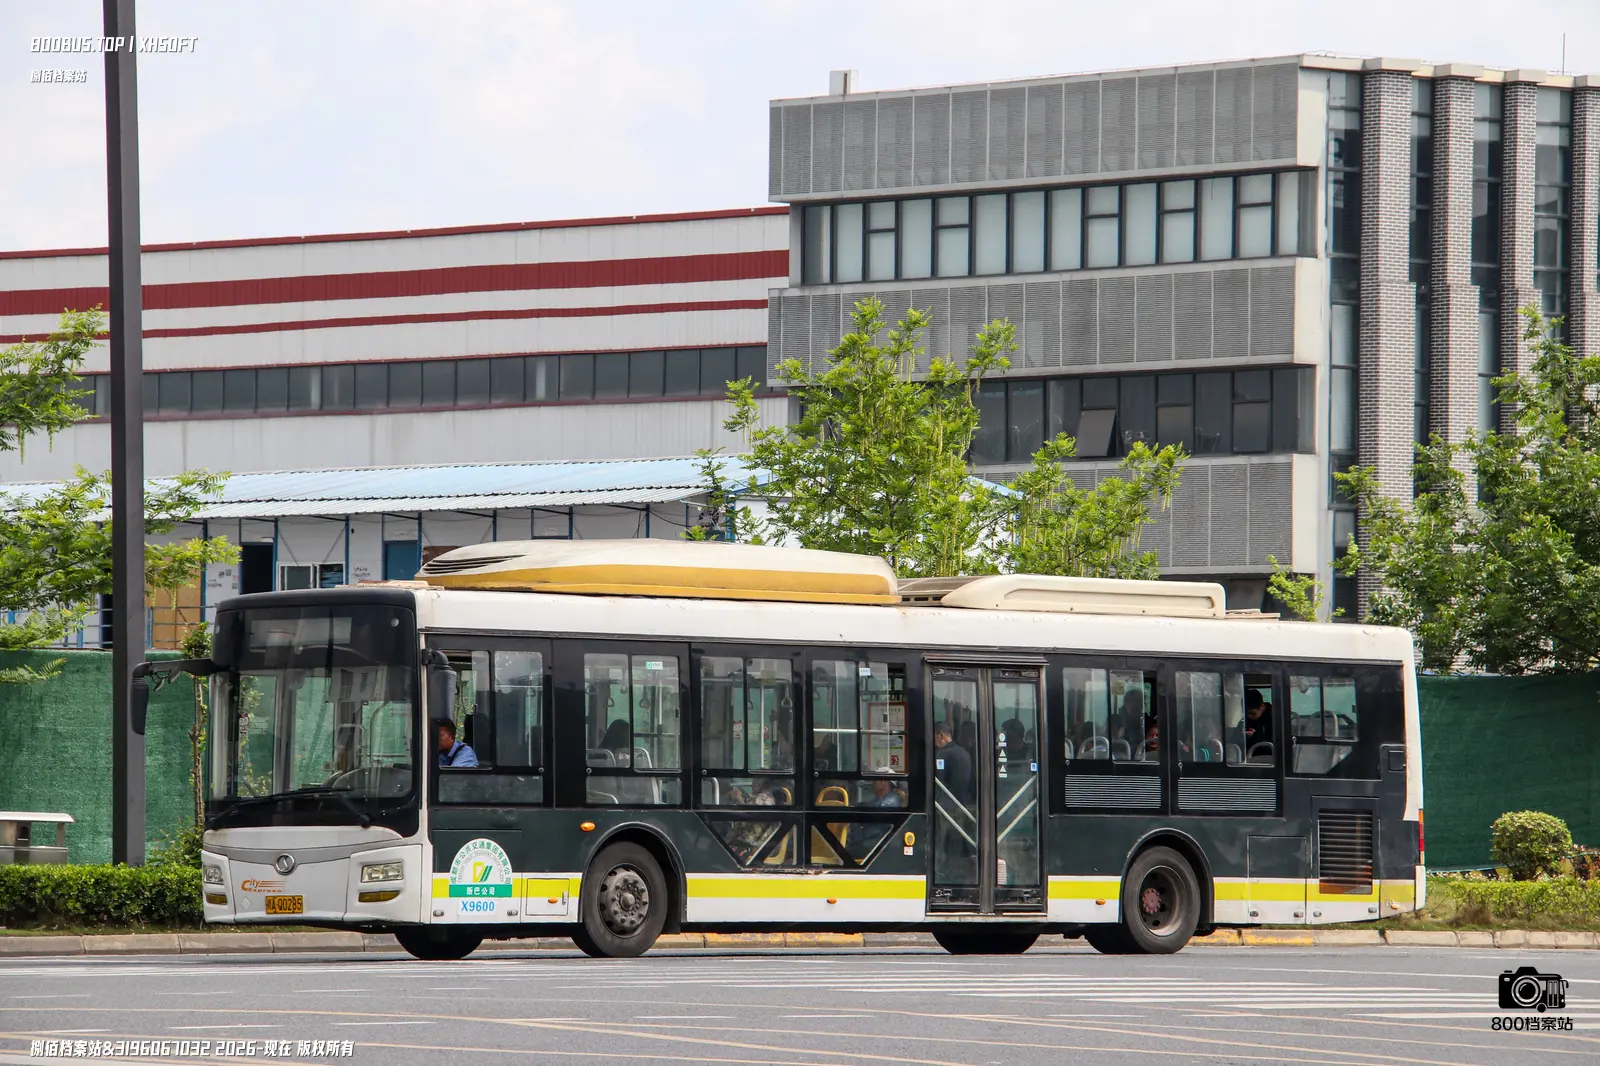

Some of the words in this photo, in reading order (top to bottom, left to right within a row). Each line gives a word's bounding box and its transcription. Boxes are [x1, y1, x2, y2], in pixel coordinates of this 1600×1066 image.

[450, 840, 512, 884] 成都市公共交通集团有限公司
[241, 879, 260, 892] City
[461, 900, 495, 912] X9600
